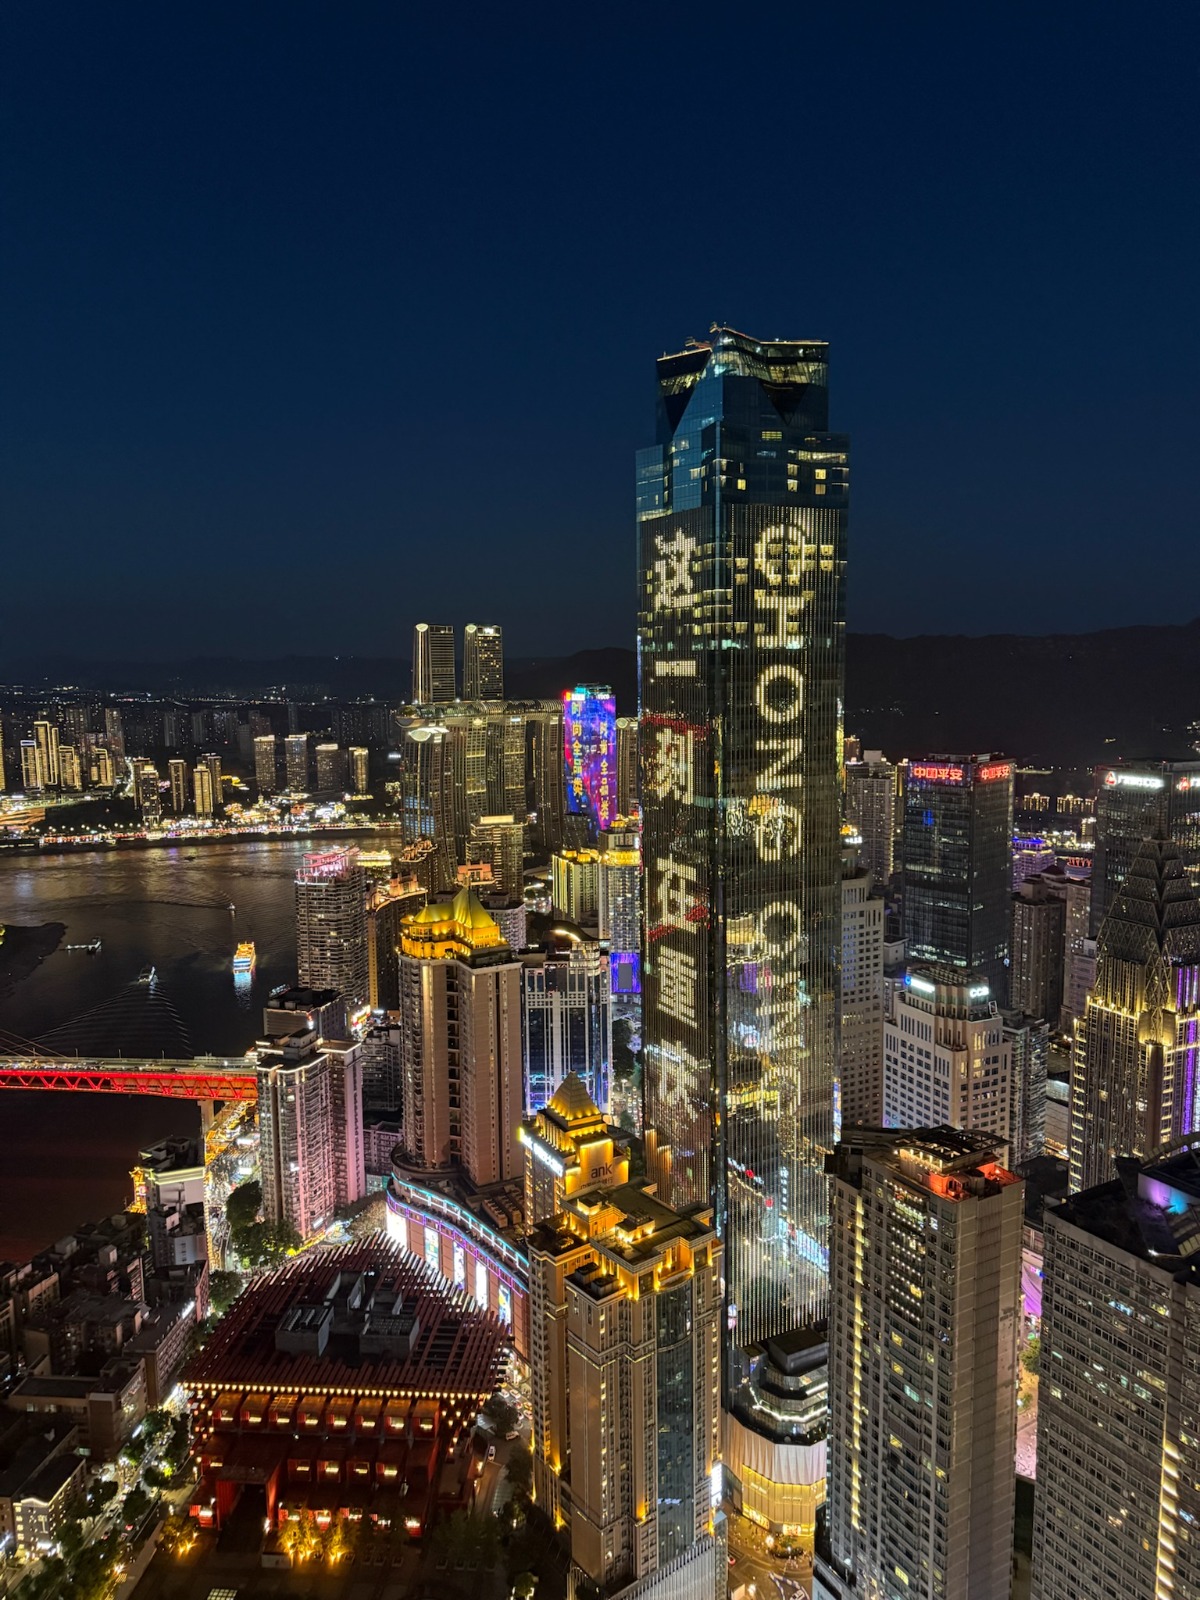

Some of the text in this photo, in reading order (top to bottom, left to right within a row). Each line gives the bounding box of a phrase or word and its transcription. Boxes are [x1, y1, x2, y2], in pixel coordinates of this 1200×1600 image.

[755, 523, 805, 861] CHONG
[913, 766, 963, 781] 中国平安
[981, 765, 1011, 780] 中国平安
[591, 1162, 613, 1178] ank
